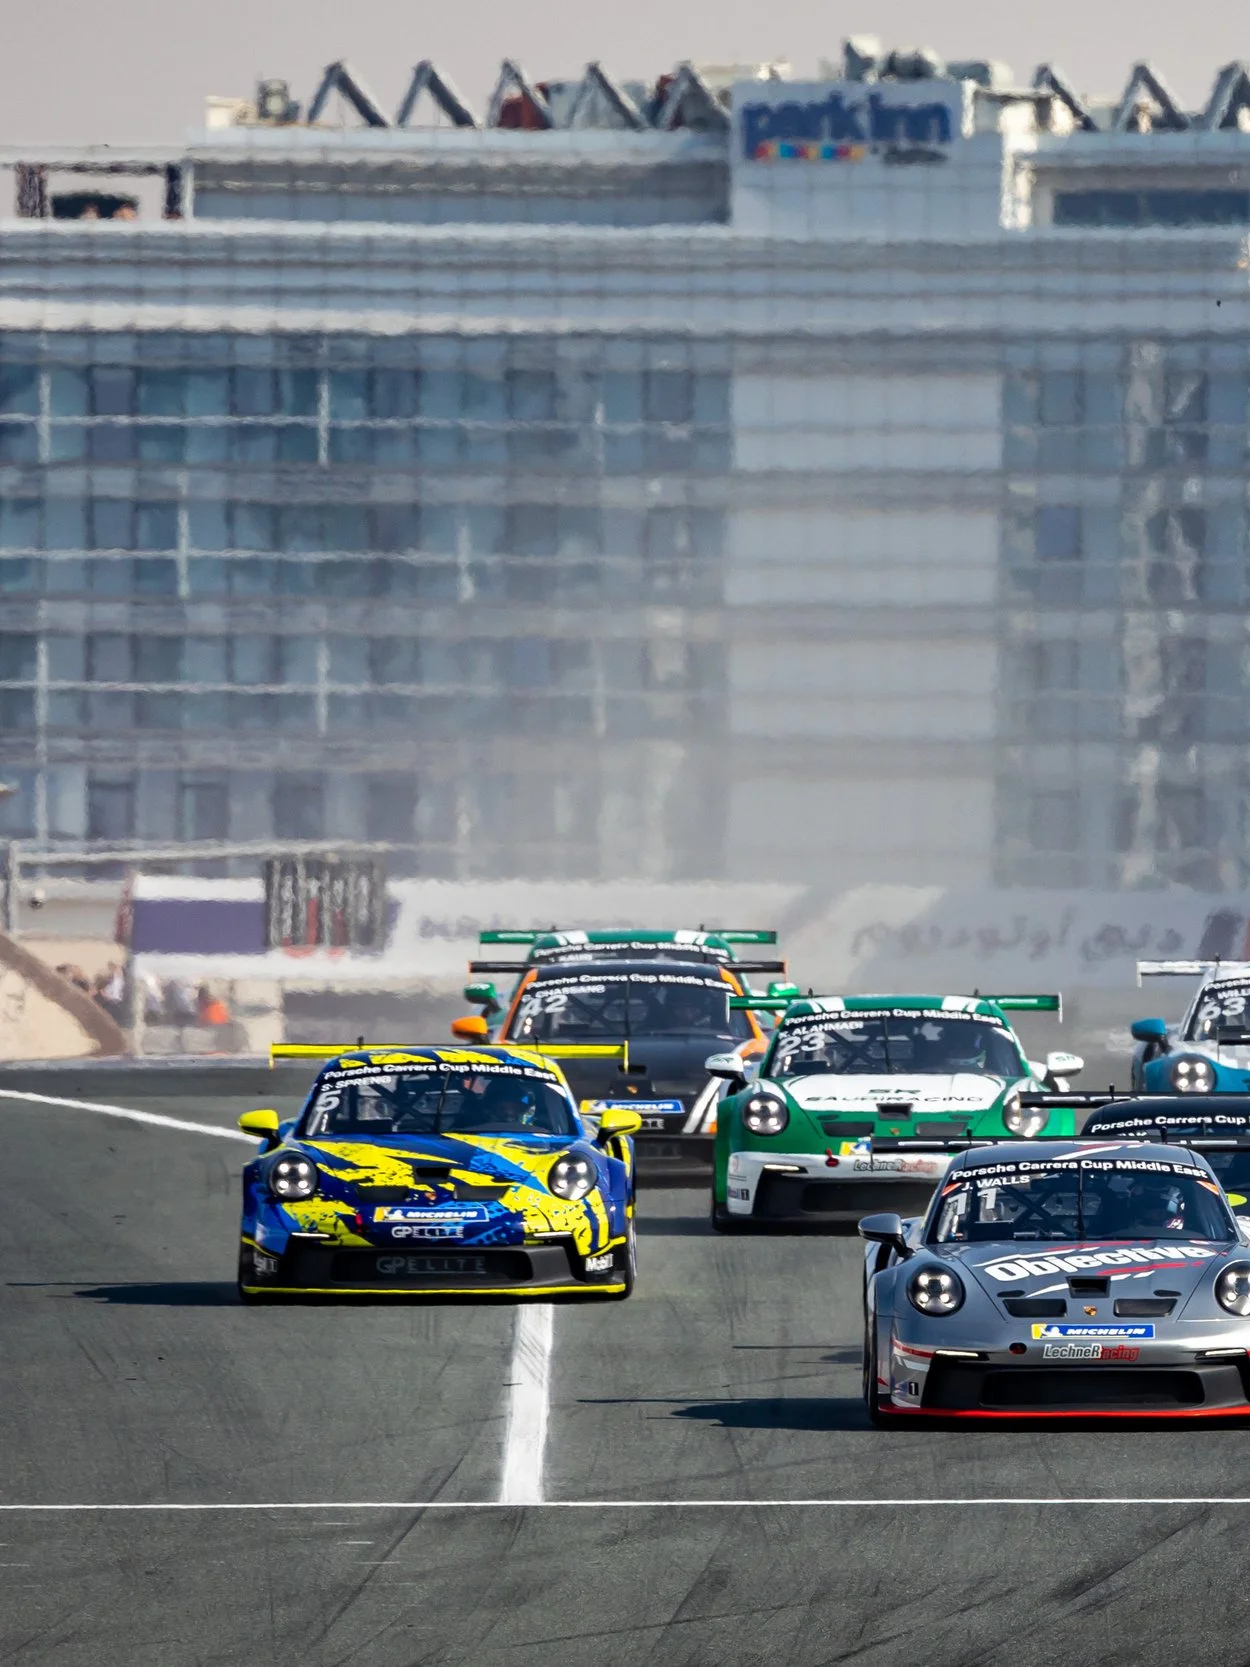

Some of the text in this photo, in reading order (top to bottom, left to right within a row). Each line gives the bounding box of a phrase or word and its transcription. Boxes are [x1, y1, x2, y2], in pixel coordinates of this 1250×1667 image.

[785, 1008, 1003, 1027] Porsche Carrera Cup Middle East
[1198, 997, 1247, 1020] 63
[778, 1033, 826, 1058] 23
[323, 1062, 557, 1081] Porsche Carrera Cup Middle East
[315, 1090, 341, 1112] 5
[1091, 1118, 1152, 1133] Porsche
[1155, 1115, 1212, 1125] Carrera
[1214, 1114, 1246, 1126] Cup
[951, 1160, 1208, 1181] Porsche Carrera Cup Middle East
[961, 1175, 1030, 1192] J. WALLS
[1066, 1327, 1147, 1336] MICHELIN
